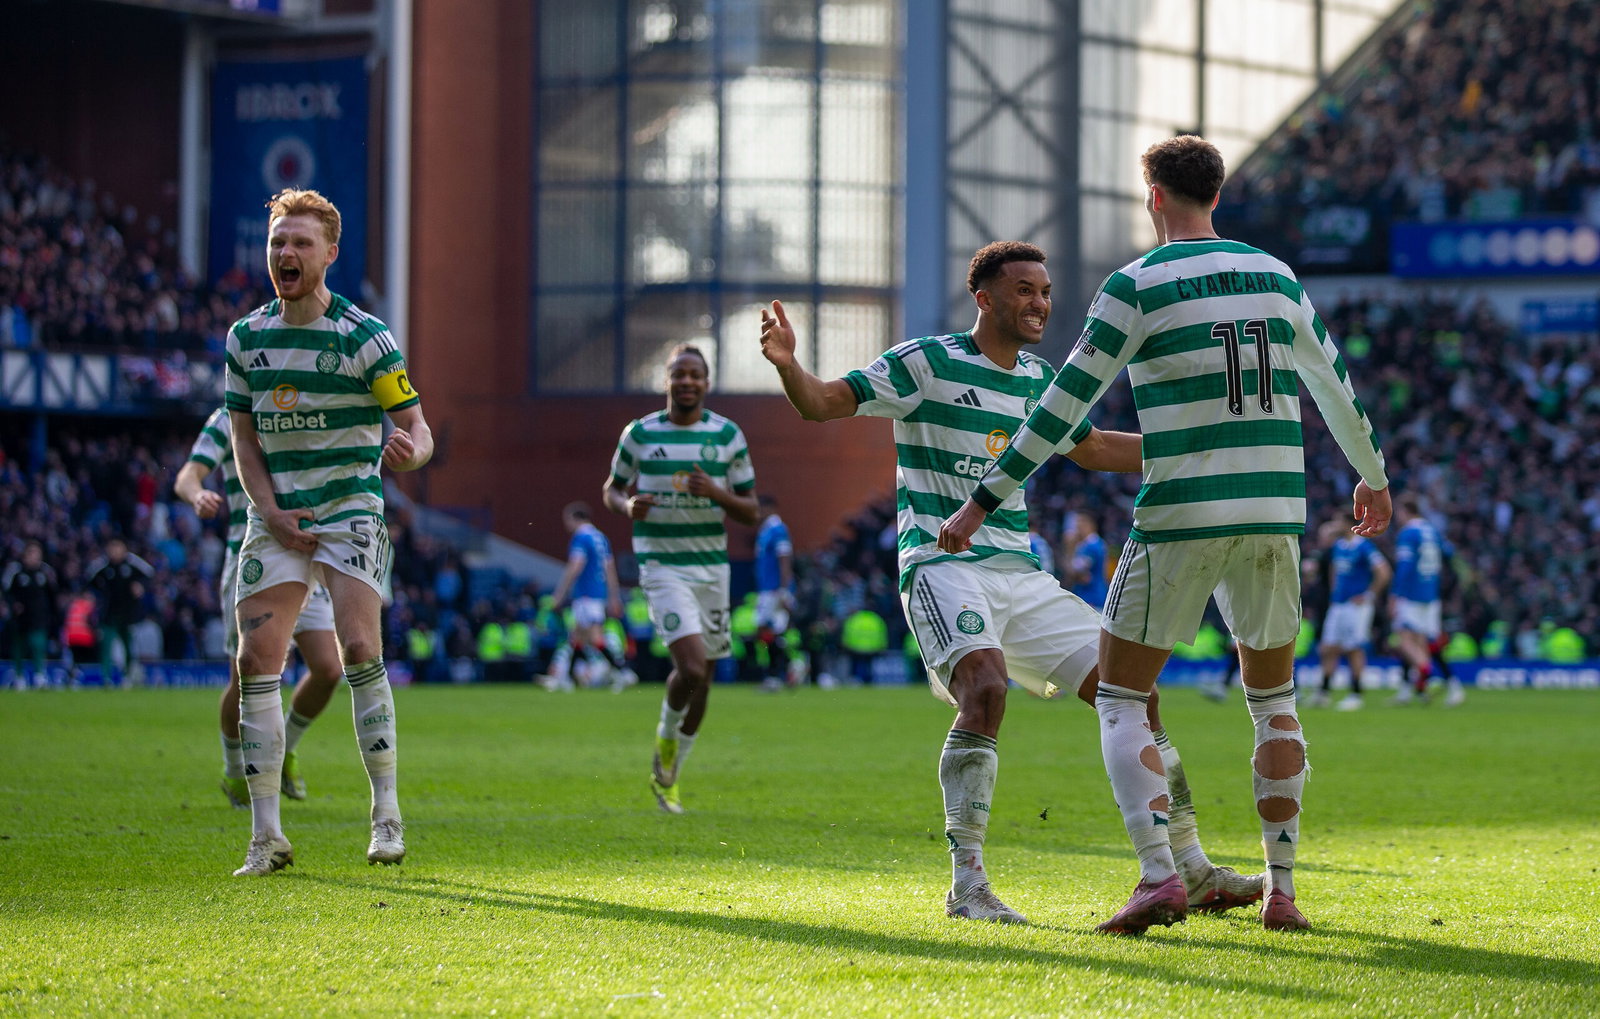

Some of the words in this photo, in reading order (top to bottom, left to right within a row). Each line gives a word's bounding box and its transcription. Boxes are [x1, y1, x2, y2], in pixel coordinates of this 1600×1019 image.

[1175, 267, 1281, 299] ČVANČARA
[1211, 319, 1274, 417] 11
[397, 375, 412, 395] C
[350, 520, 370, 548] 5
[363, 714, 390, 726] CELTIC
[972, 801, 990, 813] CELT
